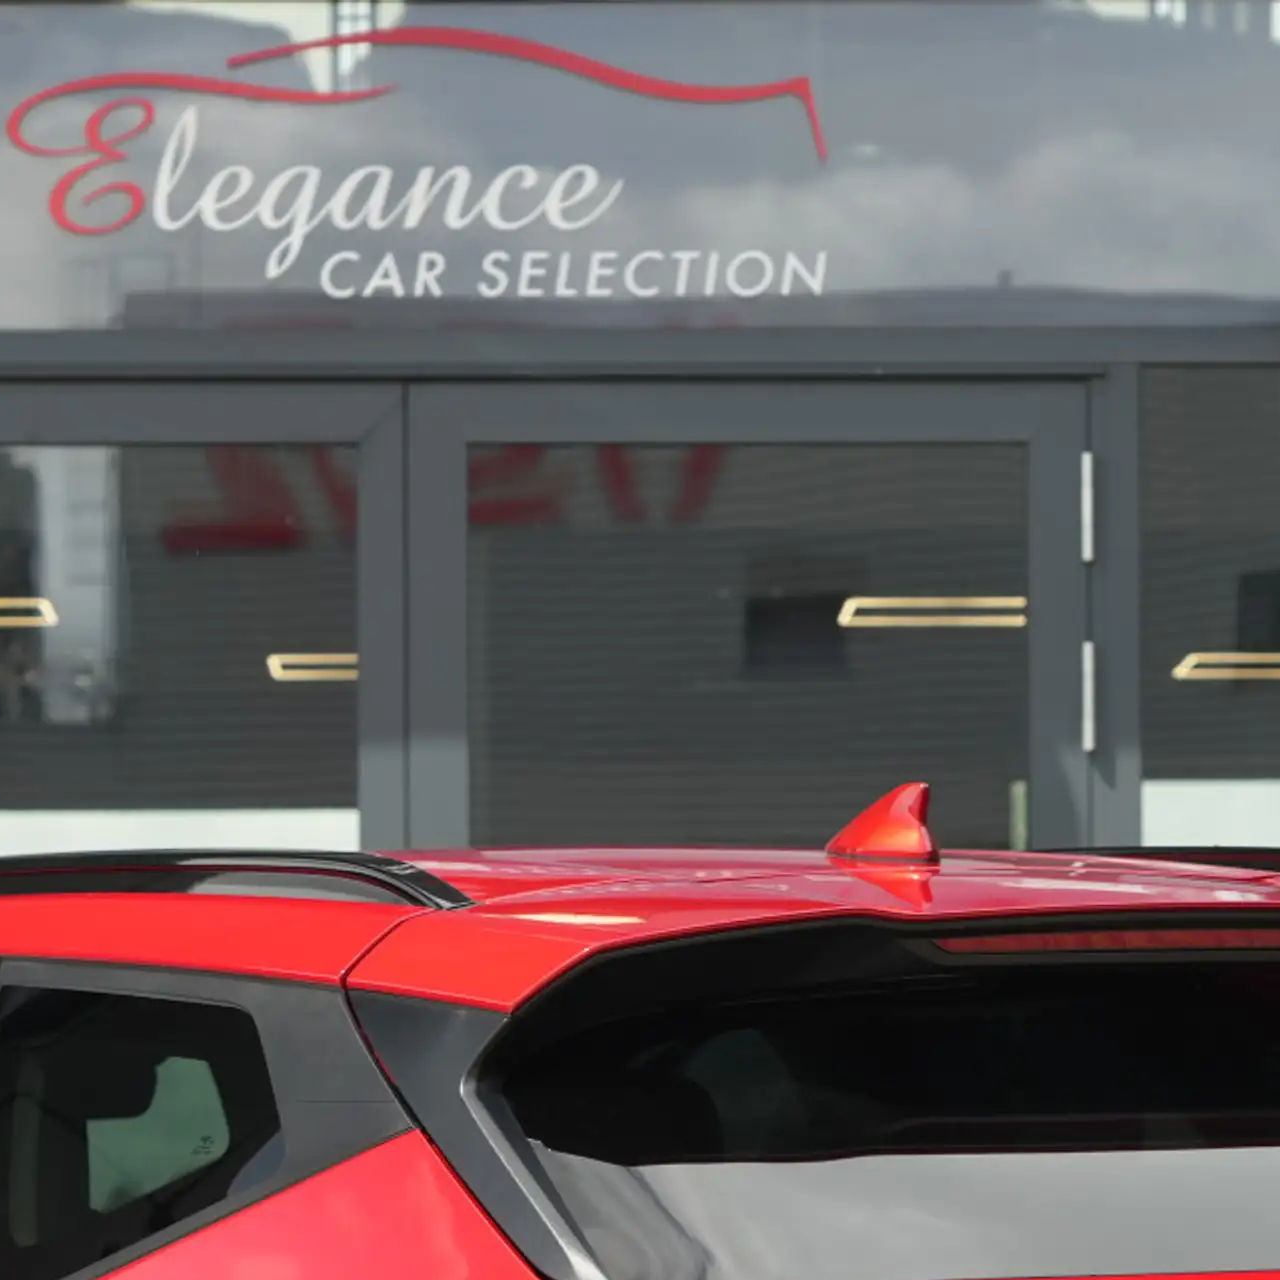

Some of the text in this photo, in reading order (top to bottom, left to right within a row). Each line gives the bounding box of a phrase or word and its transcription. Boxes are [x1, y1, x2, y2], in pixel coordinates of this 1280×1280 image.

[6, 72, 625, 280] Elegance
[320, 249, 829, 299] CAR SELECTION
